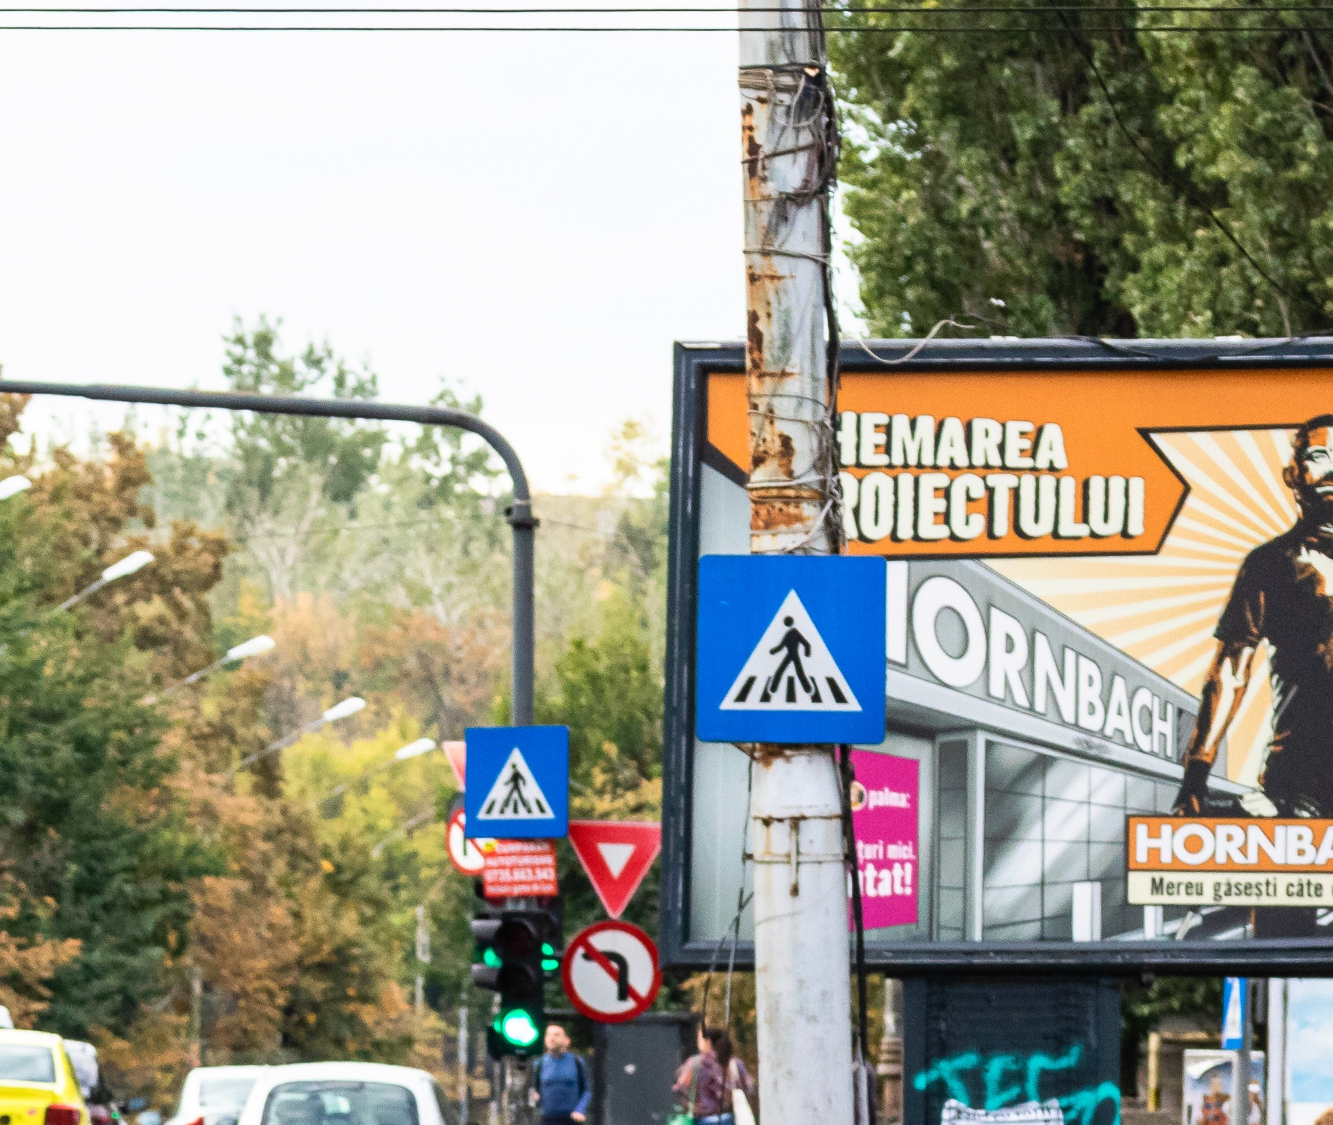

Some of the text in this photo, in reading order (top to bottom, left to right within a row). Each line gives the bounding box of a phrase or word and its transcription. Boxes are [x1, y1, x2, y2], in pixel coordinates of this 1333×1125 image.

[836, 410, 1068, 470] HEMAREA
[839, 471, 1145, 541] ROIECTULUI
[886, 561, 1174, 758] ORNBACH
[856, 861, 913, 897] tat!
[1151, 876, 1204, 896] Mereu
